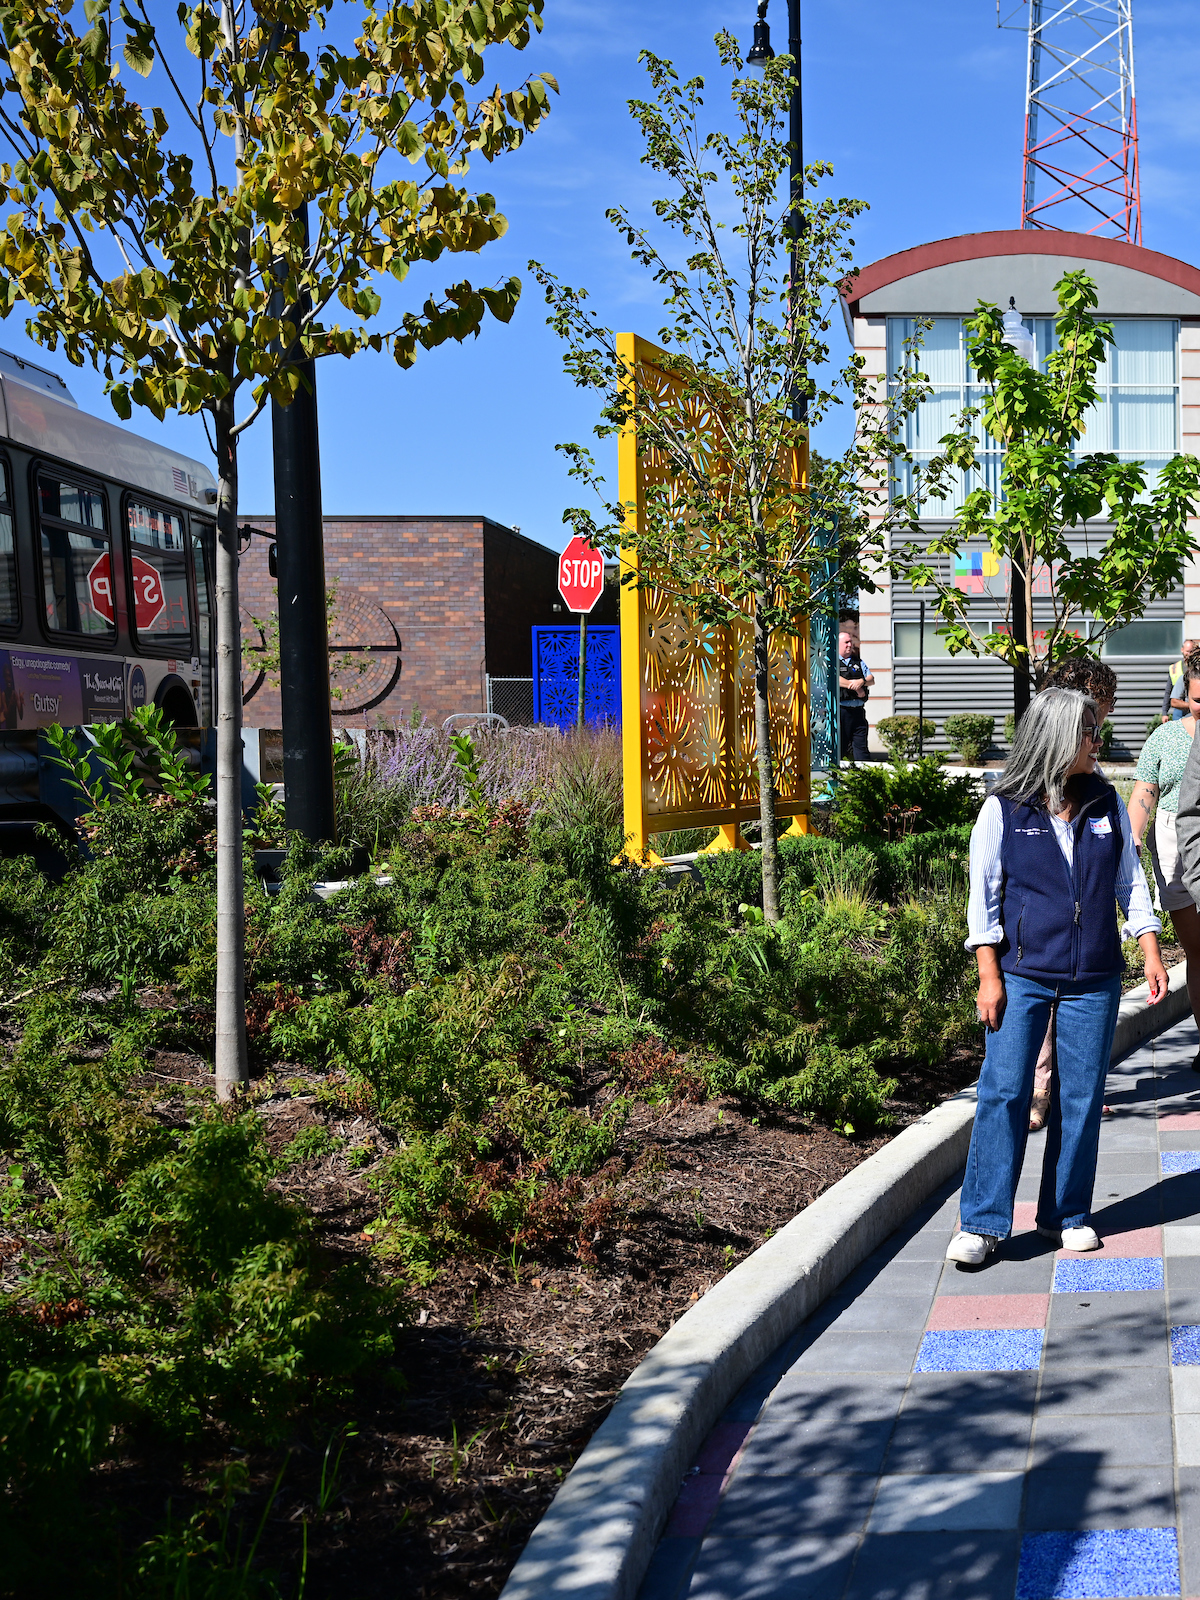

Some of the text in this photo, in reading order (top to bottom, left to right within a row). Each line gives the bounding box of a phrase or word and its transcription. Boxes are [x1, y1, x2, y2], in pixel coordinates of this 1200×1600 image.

[561, 558, 601, 588] STOP
[83, 672, 123, 700] The Second City
[132, 682, 145, 699] cta
